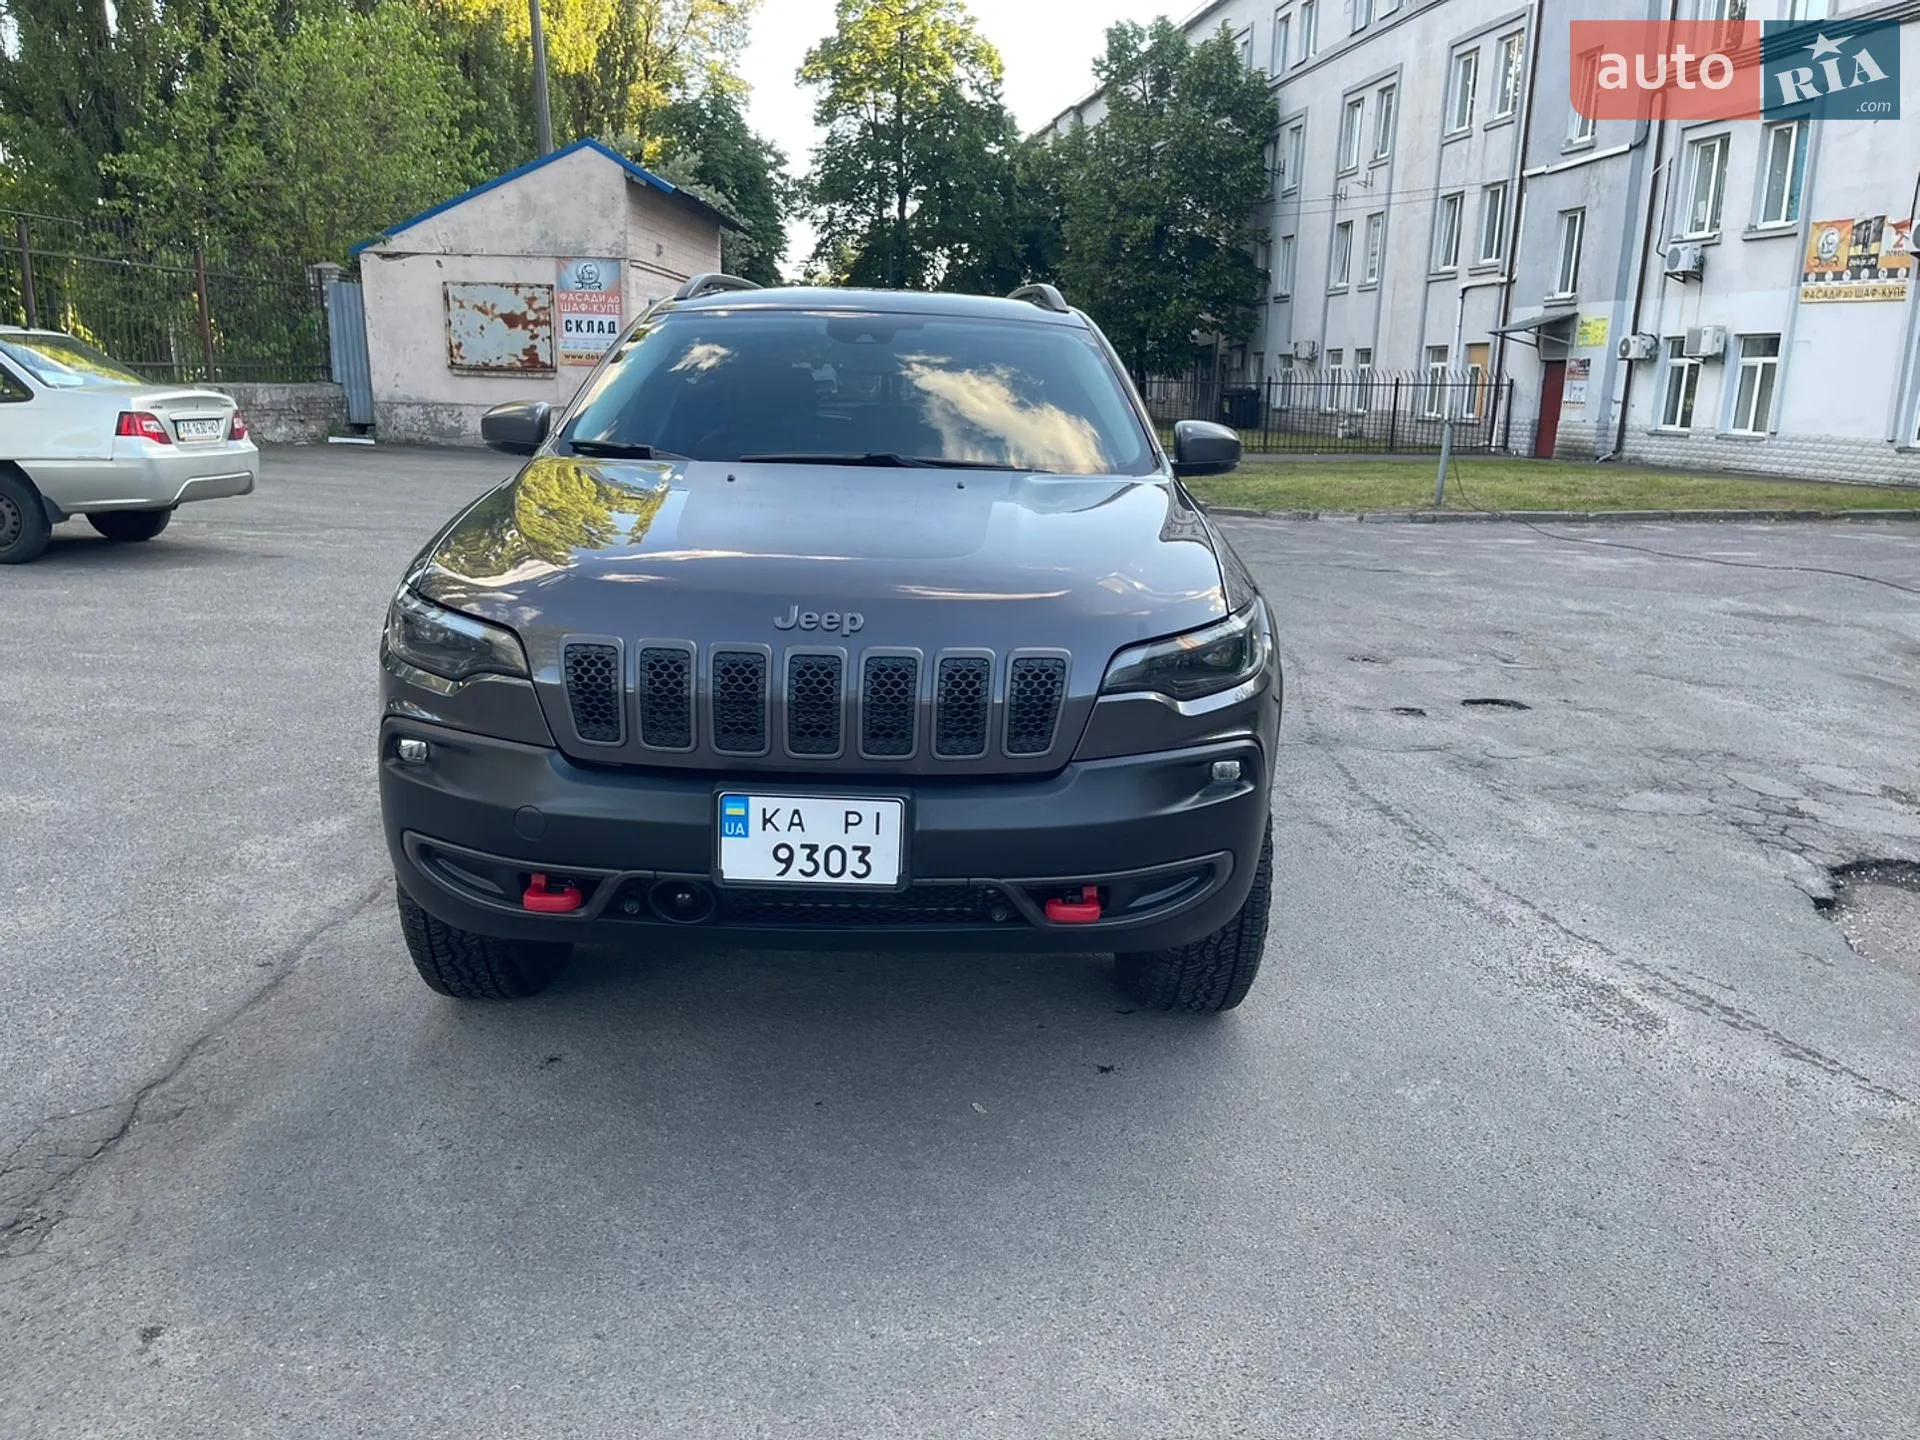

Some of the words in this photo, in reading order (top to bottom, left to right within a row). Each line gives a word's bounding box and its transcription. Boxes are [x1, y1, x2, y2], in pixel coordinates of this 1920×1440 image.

[559, 293, 606, 303] ФАСАДИ
[1803, 287, 1841, 298] ФАСАДИ
[1854, 286, 1906, 298] ШАФ-КУПЕ
[560, 302, 621, 313] ШАФ-КУПЕ
[565, 319, 617, 334] СКЛАД
[773, 605, 865, 637] Jeep
[725, 822, 745, 836] UA
[761, 808, 806, 833] KA
[772, 843, 872, 879] 9303
